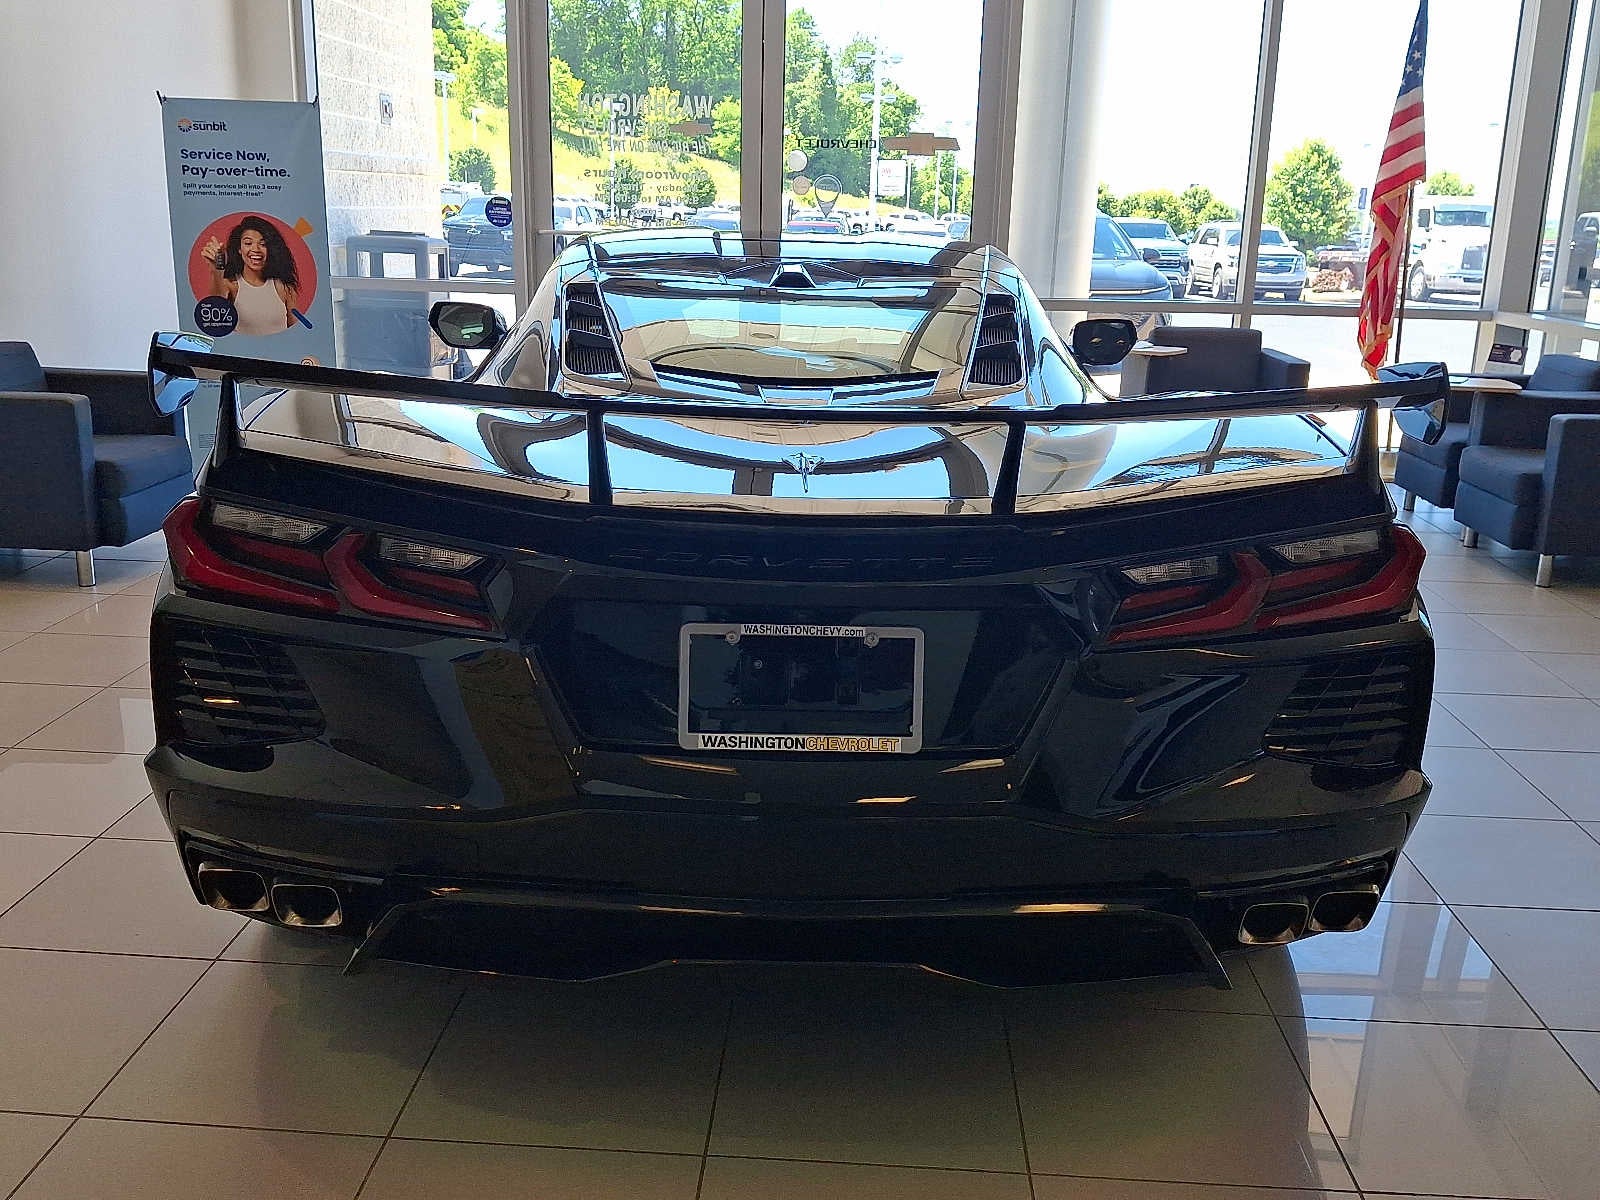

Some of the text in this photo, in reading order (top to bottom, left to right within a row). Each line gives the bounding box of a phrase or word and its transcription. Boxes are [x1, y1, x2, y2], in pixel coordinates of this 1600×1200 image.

[192, 121, 227, 131] sunbit
[180, 148, 270, 162] Service Now,
[182, 164, 291, 179] Pay-over-time.
[183, 189, 218, 197] payments,
[201, 308, 233, 321] 90%
[743, 623, 865, 638] WASHINGTONCHEVY.com
